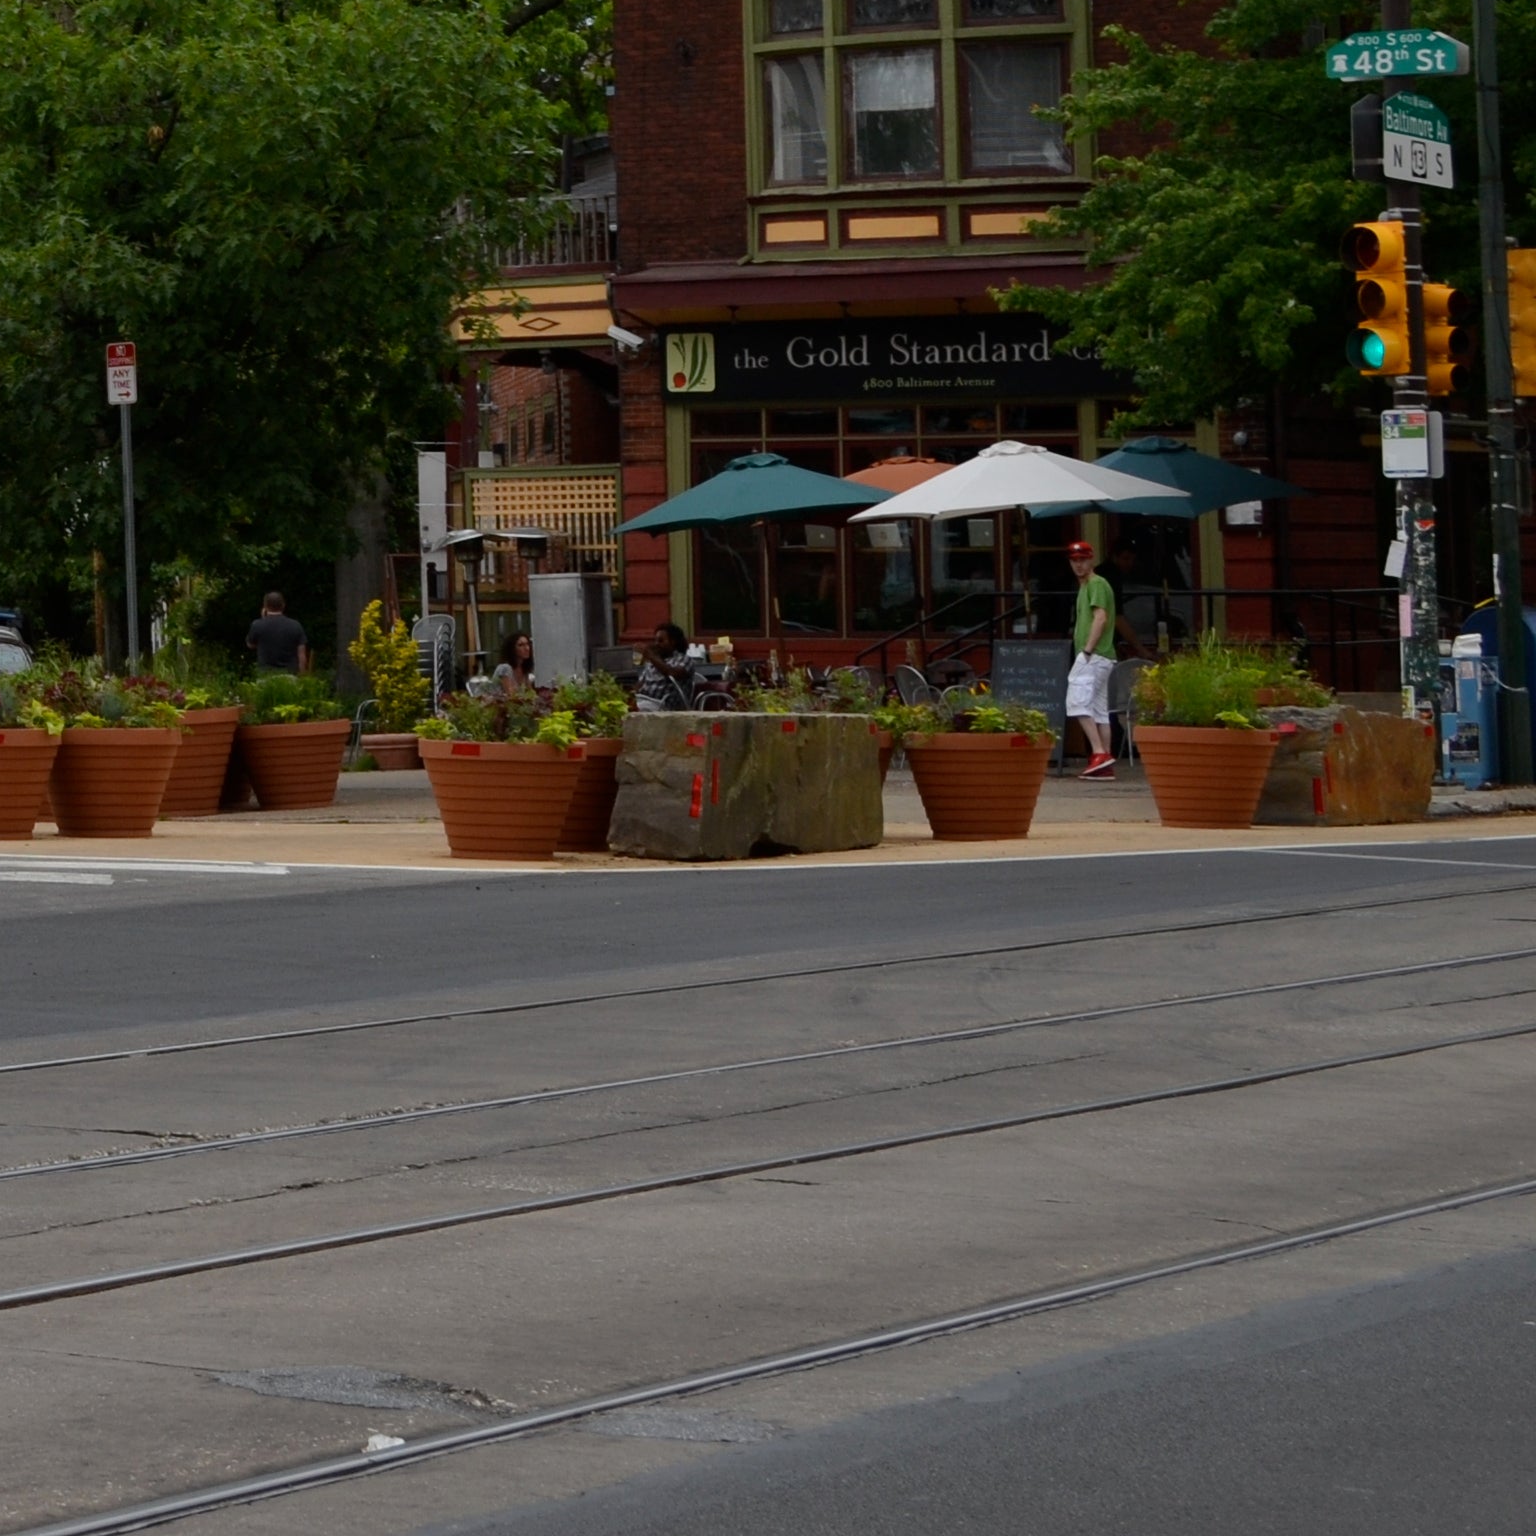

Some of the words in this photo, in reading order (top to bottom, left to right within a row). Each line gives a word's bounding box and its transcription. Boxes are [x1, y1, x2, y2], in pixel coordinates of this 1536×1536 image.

[1386, 33, 1397, 46] S
[1399, 33, 1422, 44] 600
[1353, 49, 1409, 74] 48th
[1416, 48, 1446, 72] St
[1386, 105, 1434, 139] Baltimore
[1393, 144, 1403, 168] N
[1413, 150, 1424, 170] 13
[1436, 152, 1444, 176] S
[734, 348, 769, 369] the
[786, 334, 870, 368] Gold
[889, 329, 1051, 366] Standard
[113, 368, 130, 378] ANY
[112, 379, 131, 389] TIME
[862, 377, 893, 391] 4800
[897, 376, 951, 389] Baltimore
[954, 375, 996, 388] Avenue
[1383, 426, 1399, 439] 34
